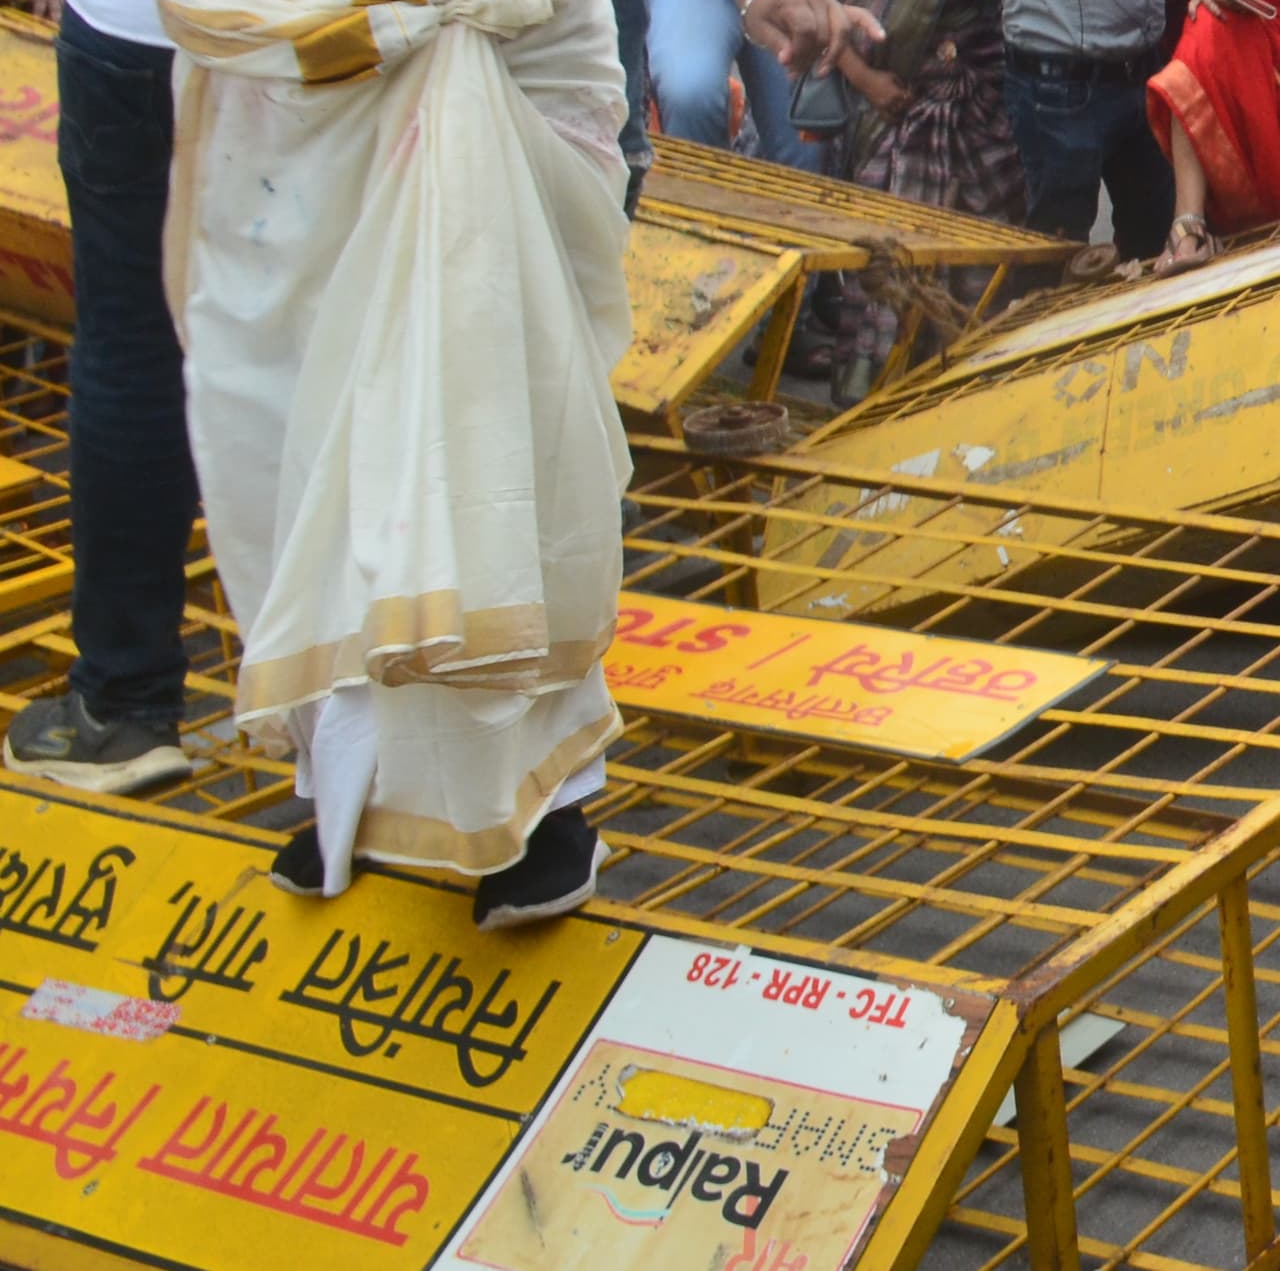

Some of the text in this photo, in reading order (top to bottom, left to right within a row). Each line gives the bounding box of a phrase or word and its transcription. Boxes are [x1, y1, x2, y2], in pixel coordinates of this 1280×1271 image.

[806, 642, 1040, 704] ठहरिये
[685, 952, 743, 991] 128
[763, 968, 832, 1010] RPR
[278, 928, 563, 1089] नियंत्रित
[849, 987, 913, 1029] TFC
[136, 1095, 430, 1248] यातायात
[561, 1120, 790, 1231] Raipur
